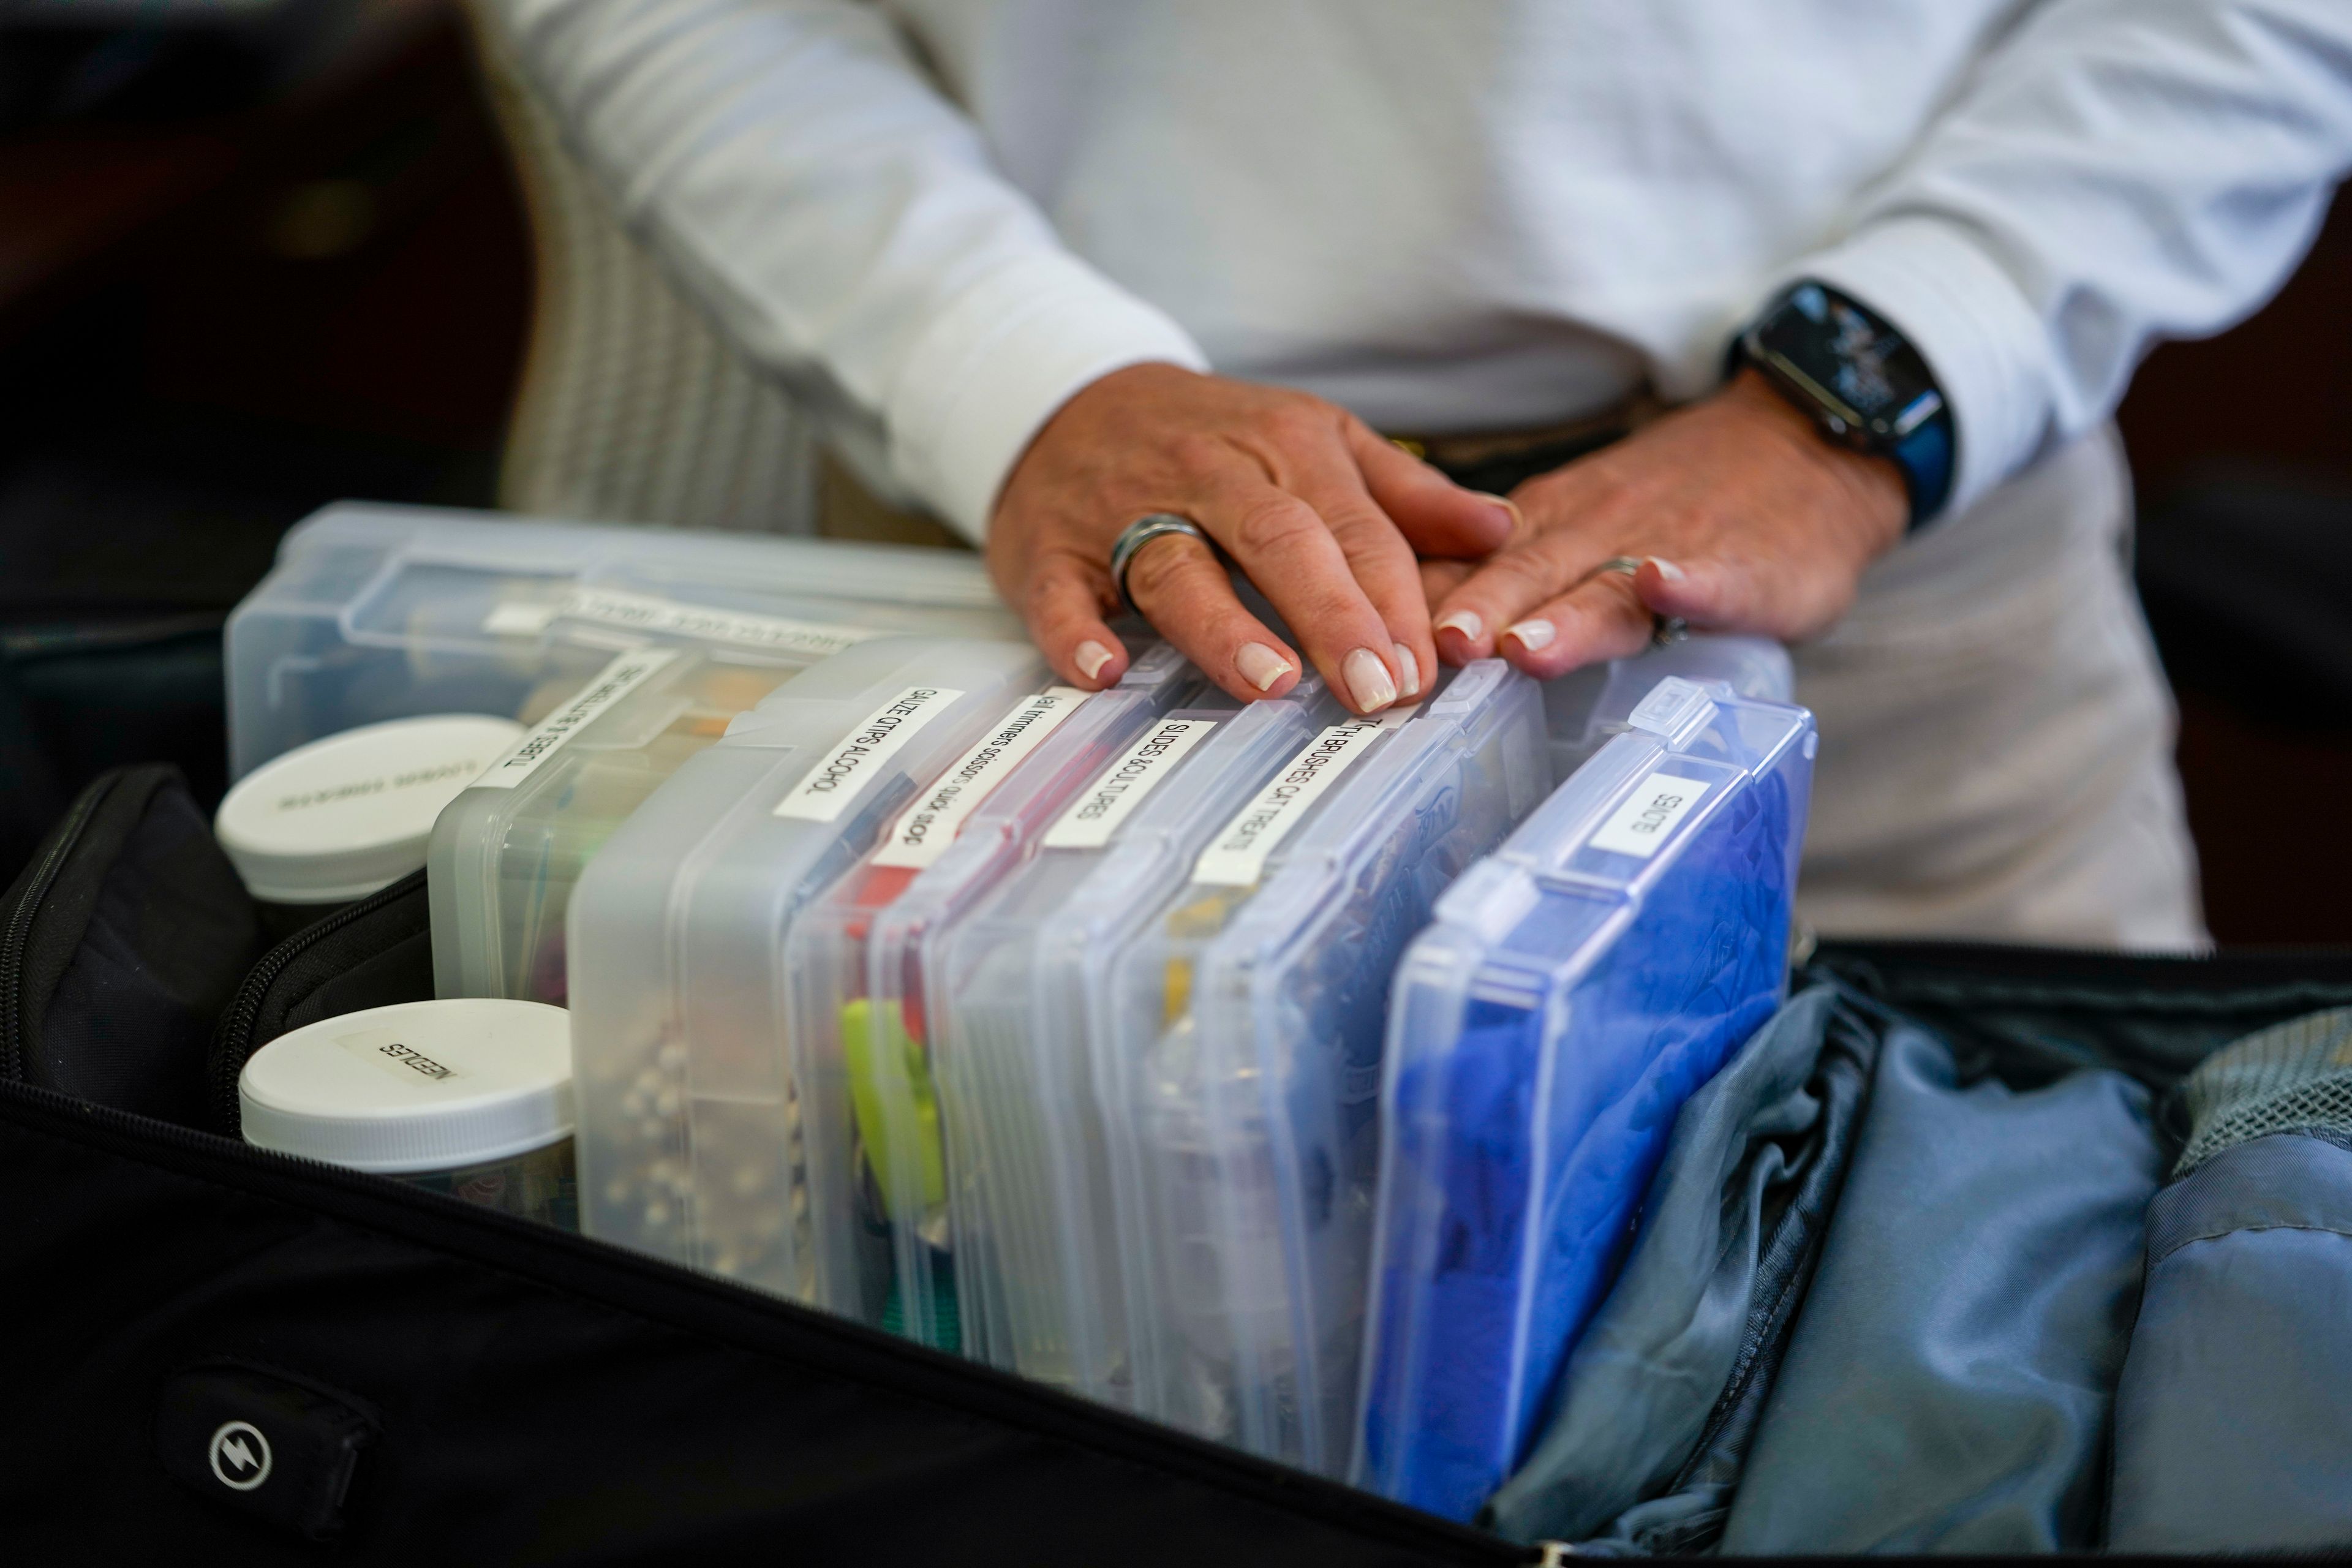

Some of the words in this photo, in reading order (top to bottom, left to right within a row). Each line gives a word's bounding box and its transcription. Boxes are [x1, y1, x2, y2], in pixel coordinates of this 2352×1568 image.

[886, 689, 938, 715] GAUZE
[856, 717, 903, 744] QTIPS
[991, 710, 1046, 747] trimmers
[1137, 724, 1189, 756] SLIDES
[503, 734, 559, 767] TUBES
[952, 747, 1001, 785] scissors
[1285, 739, 1349, 785] BRUSHES
[805, 745, 871, 795] ALCOHOL
[927, 786, 962, 812] quick
[1265, 785, 1300, 807] CAT
[903, 813, 935, 846] stop
[1631, 794, 1683, 834] GLOVES
[379, 1044, 458, 1080] NEEDLES
